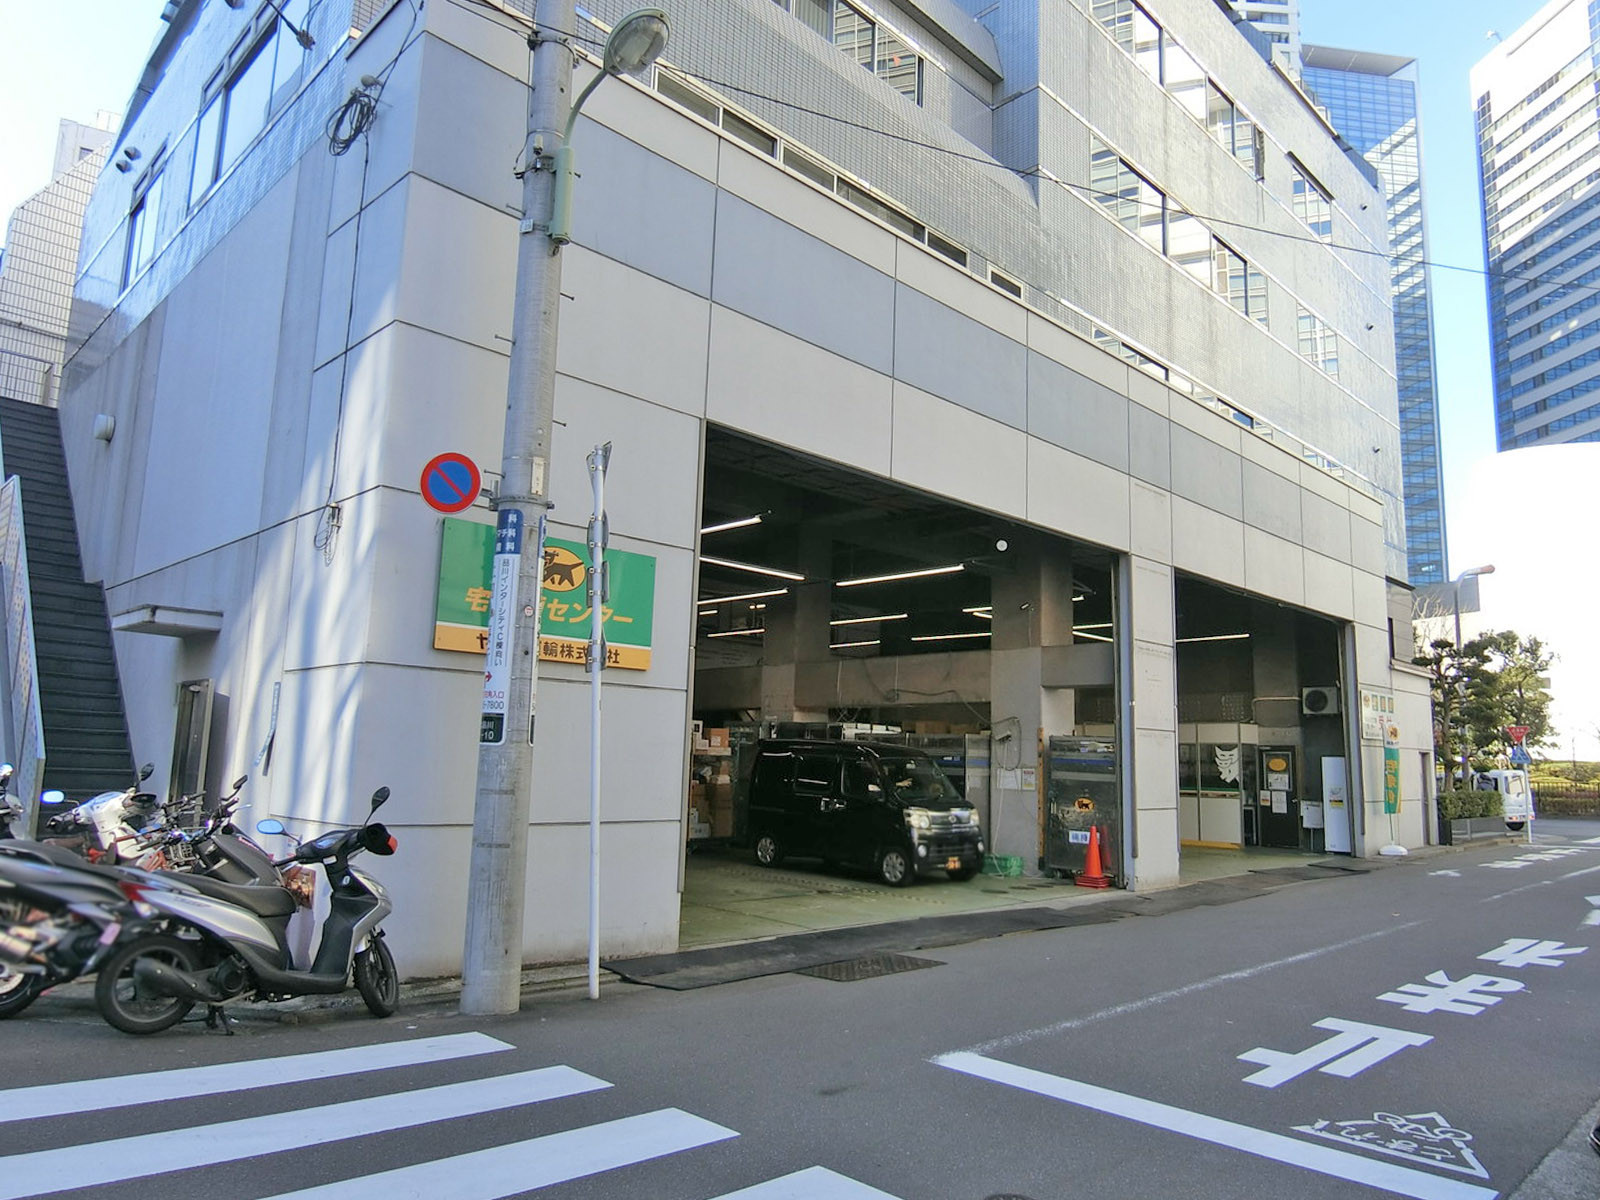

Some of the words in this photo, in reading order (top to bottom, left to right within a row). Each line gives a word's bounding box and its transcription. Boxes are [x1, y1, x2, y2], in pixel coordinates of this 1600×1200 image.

[465, 587, 633, 624] 宅センター
